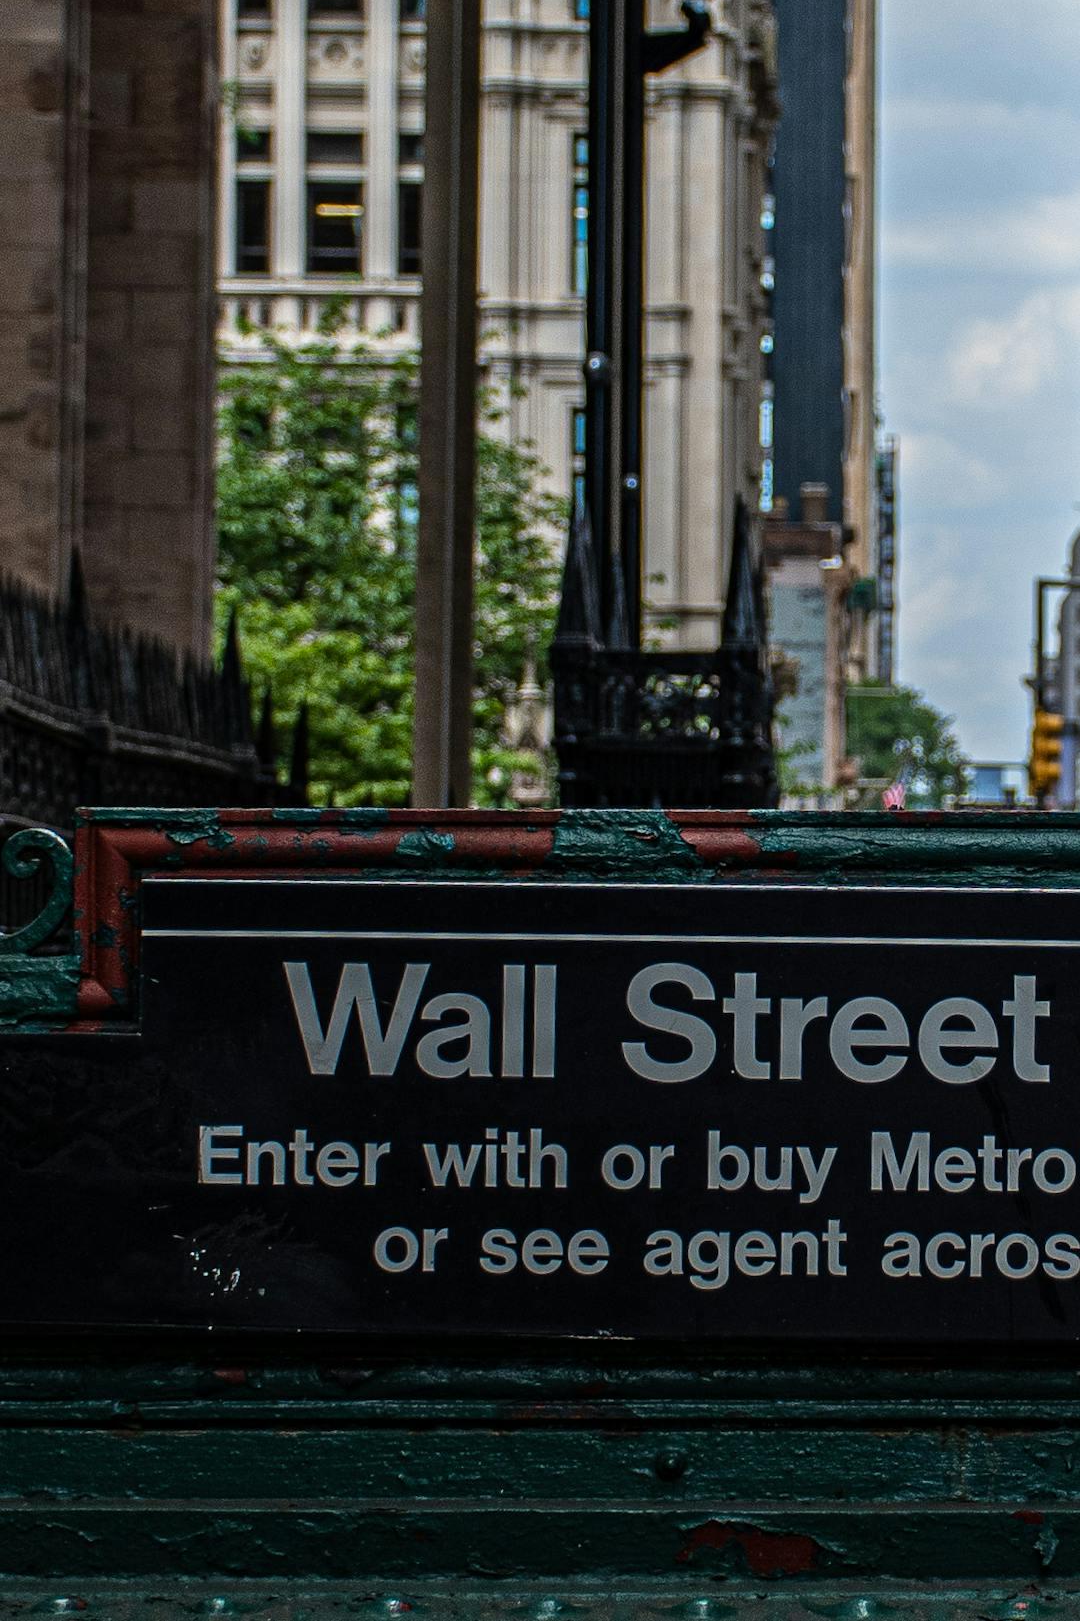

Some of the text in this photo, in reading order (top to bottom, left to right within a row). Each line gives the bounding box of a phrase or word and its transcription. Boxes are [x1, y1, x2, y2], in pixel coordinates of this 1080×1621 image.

[281, 960, 558, 1079] Wall
[620, 961, 1052, 1085] Street
[196, 1124, 392, 1188] Enter
[422, 1126, 569, 1190] with
[600, 1143, 676, 1192] or
[706, 1130, 838, 1205] buy
[373, 1225, 450, 1274] or
[478, 1227, 611, 1276] see
[642, 1218, 848, 1291] agent
